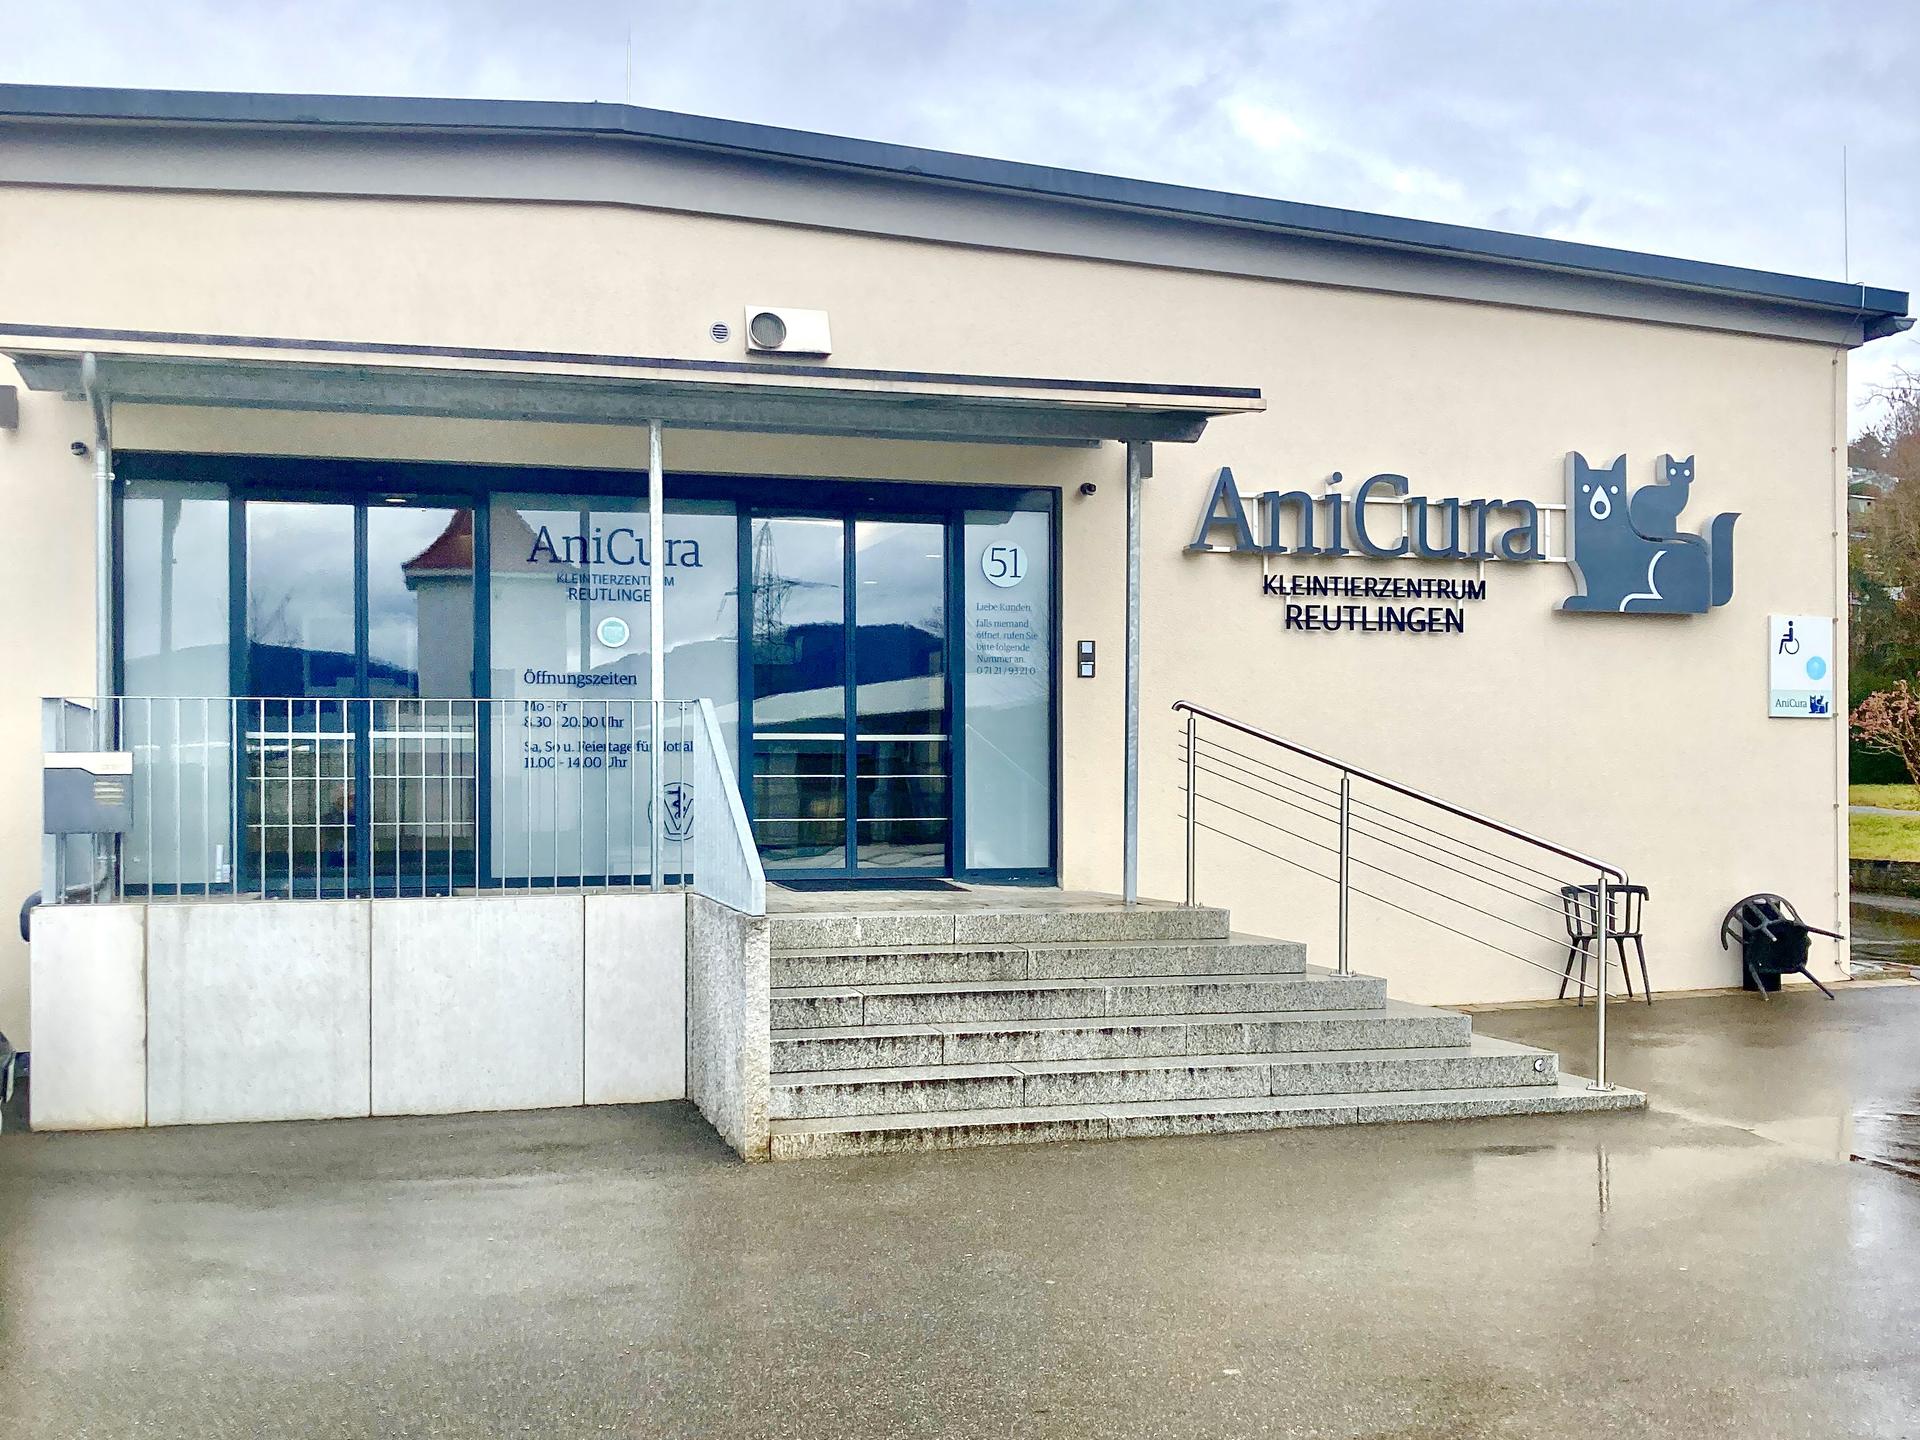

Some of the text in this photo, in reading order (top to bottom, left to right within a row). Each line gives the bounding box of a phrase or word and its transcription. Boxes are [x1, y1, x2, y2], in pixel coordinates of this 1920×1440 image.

[1184, 466, 1546, 562] AniCura
[526, 525, 703, 568] AniCura
[989, 547, 1022, 578] 51
[556, 573, 675, 587] KLEINTIERZENTM
[1263, 575, 1487, 600] KLEINTIERZENTRUM
[568, 587, 652, 602] REUTLINGE
[976, 602, 998, 611] Liebe
[976, 619, 1029, 628] falls niemand
[1285, 604, 1466, 633] REUTLINGEN
[1004, 631, 1025, 640] rufen
[1026, 631, 1039, 640] Sie
[976, 642, 1031, 653] bitte folgende
[976, 654, 1012, 663] Nummer
[524, 669, 637, 688] Öffnungszeiten
[1775, 698, 1807, 708] AniCura
[561, 716, 599, 728] 20.00
[601, 716, 625, 728] Uhr
[545, 741, 561, 752] So
[563, 743, 575, 752] u.
[567, 757, 602, 768] 14.00
